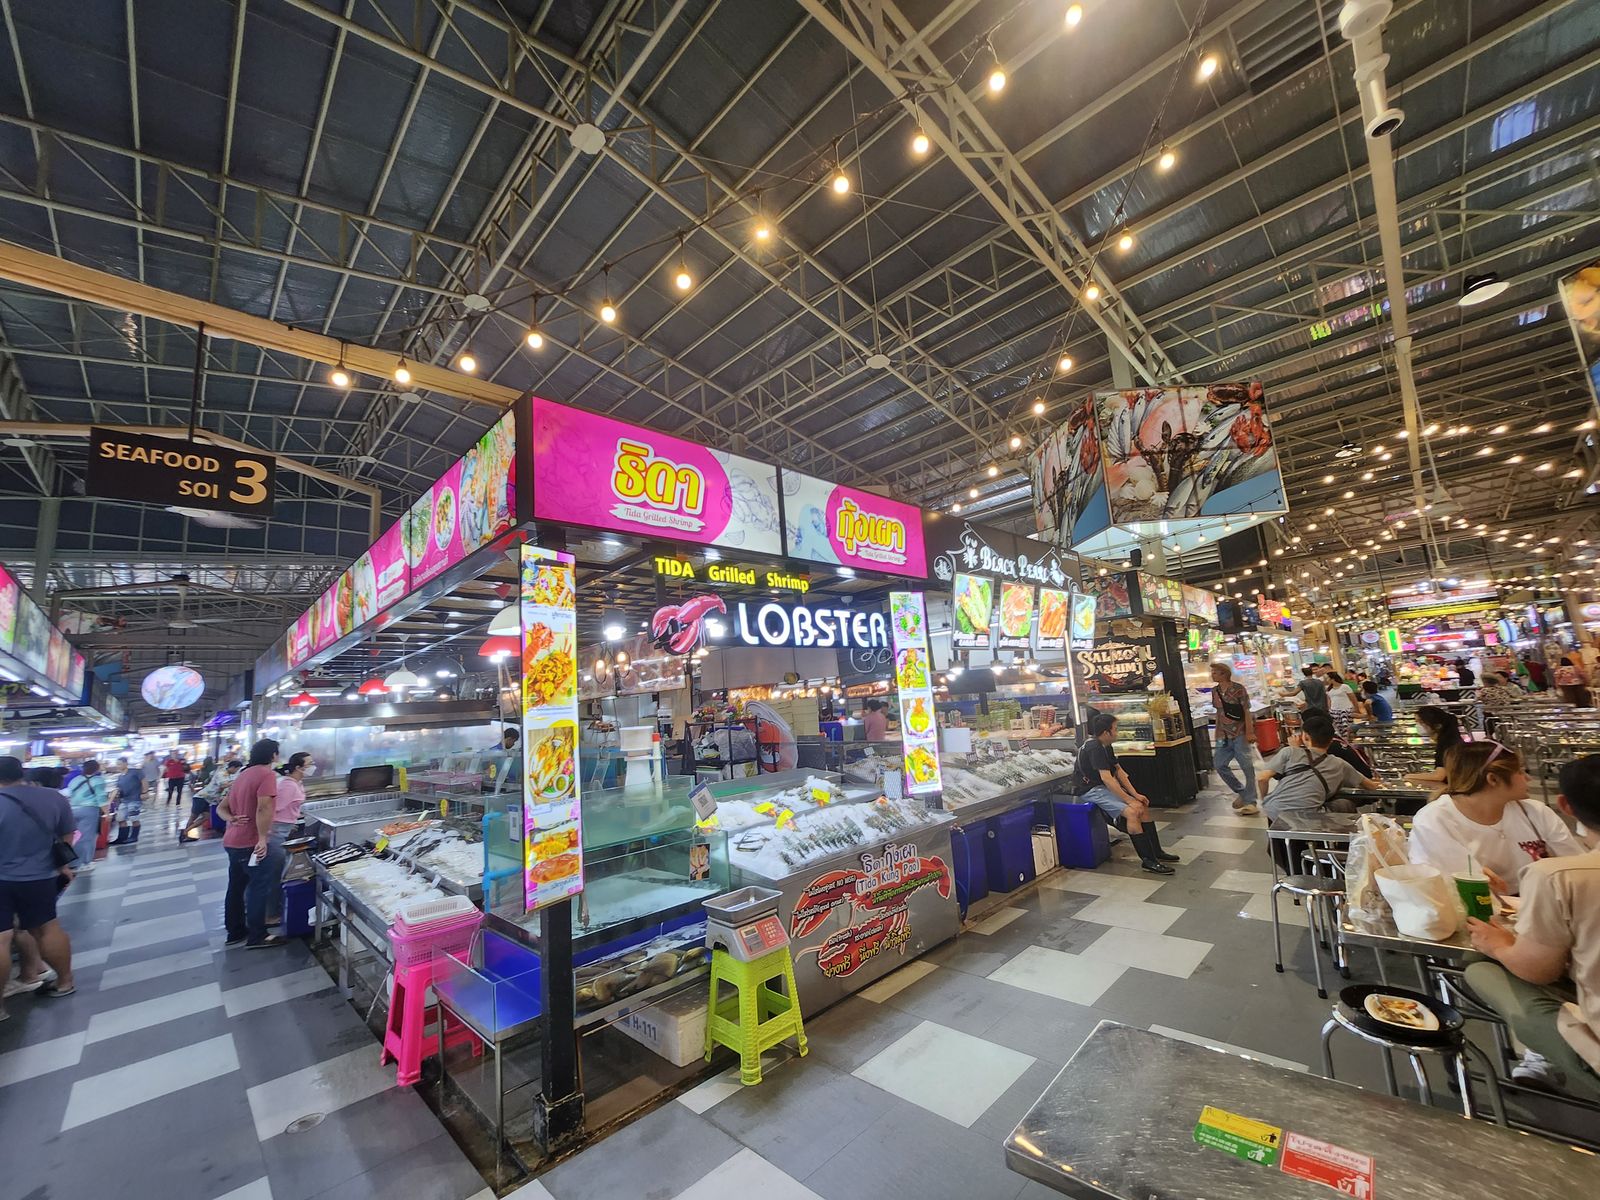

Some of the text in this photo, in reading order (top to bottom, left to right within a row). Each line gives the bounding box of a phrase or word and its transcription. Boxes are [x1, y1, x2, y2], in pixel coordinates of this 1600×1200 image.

[99, 442, 220, 472] SEAFOOD
[615, 442, 700, 510] ธิดา
[178, 459, 268, 505] SOI 3
[625, 508, 693, 528] Tida Grilled Shrimp
[838, 500, 903, 551] กุ้งเผา
[655, 557, 810, 593] TIDA Grilled Shrimp
[738, 602, 889, 648] LOBSTER
[881, 870, 899, 882] Kung
